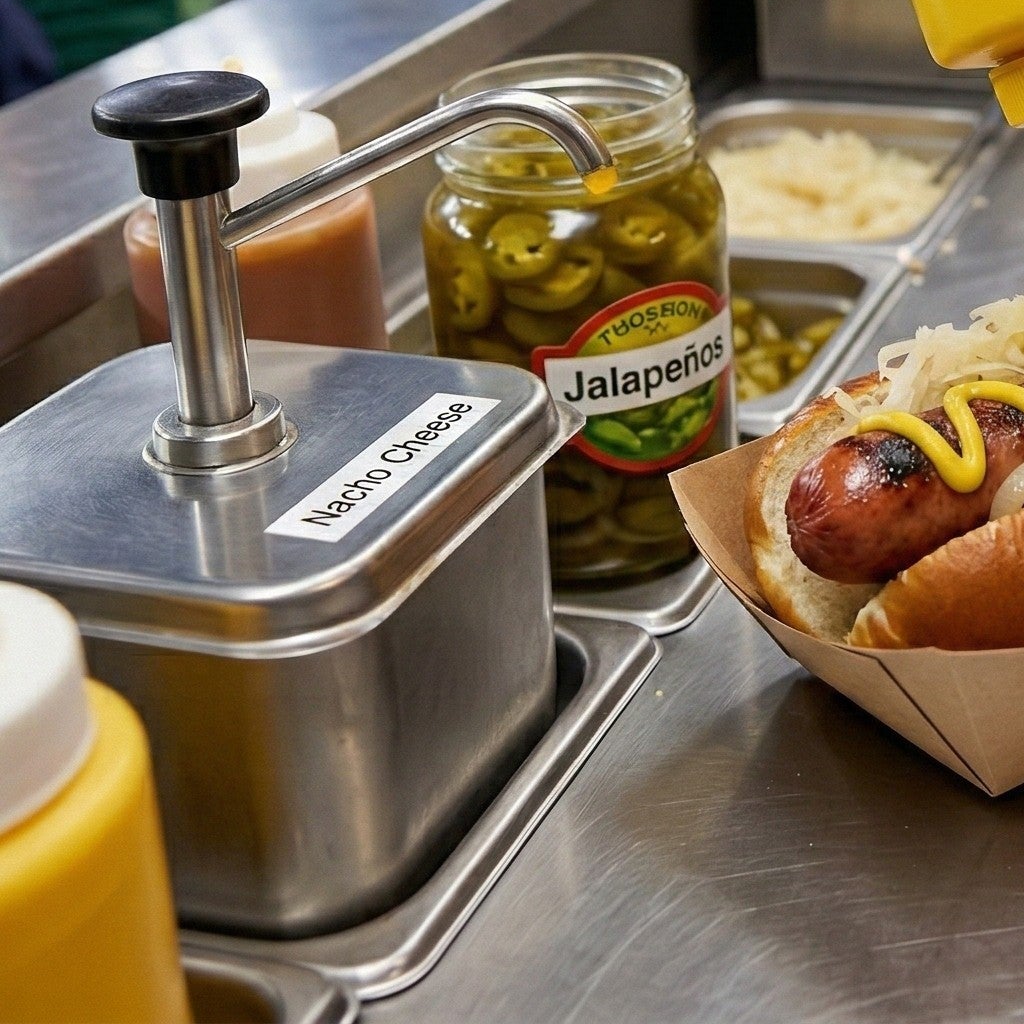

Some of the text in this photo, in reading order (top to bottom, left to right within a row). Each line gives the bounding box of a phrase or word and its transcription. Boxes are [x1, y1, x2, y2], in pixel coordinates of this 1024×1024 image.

[564, 335, 724, 402] Jalapeños
[301, 403, 473, 526] Nacho Cheese
